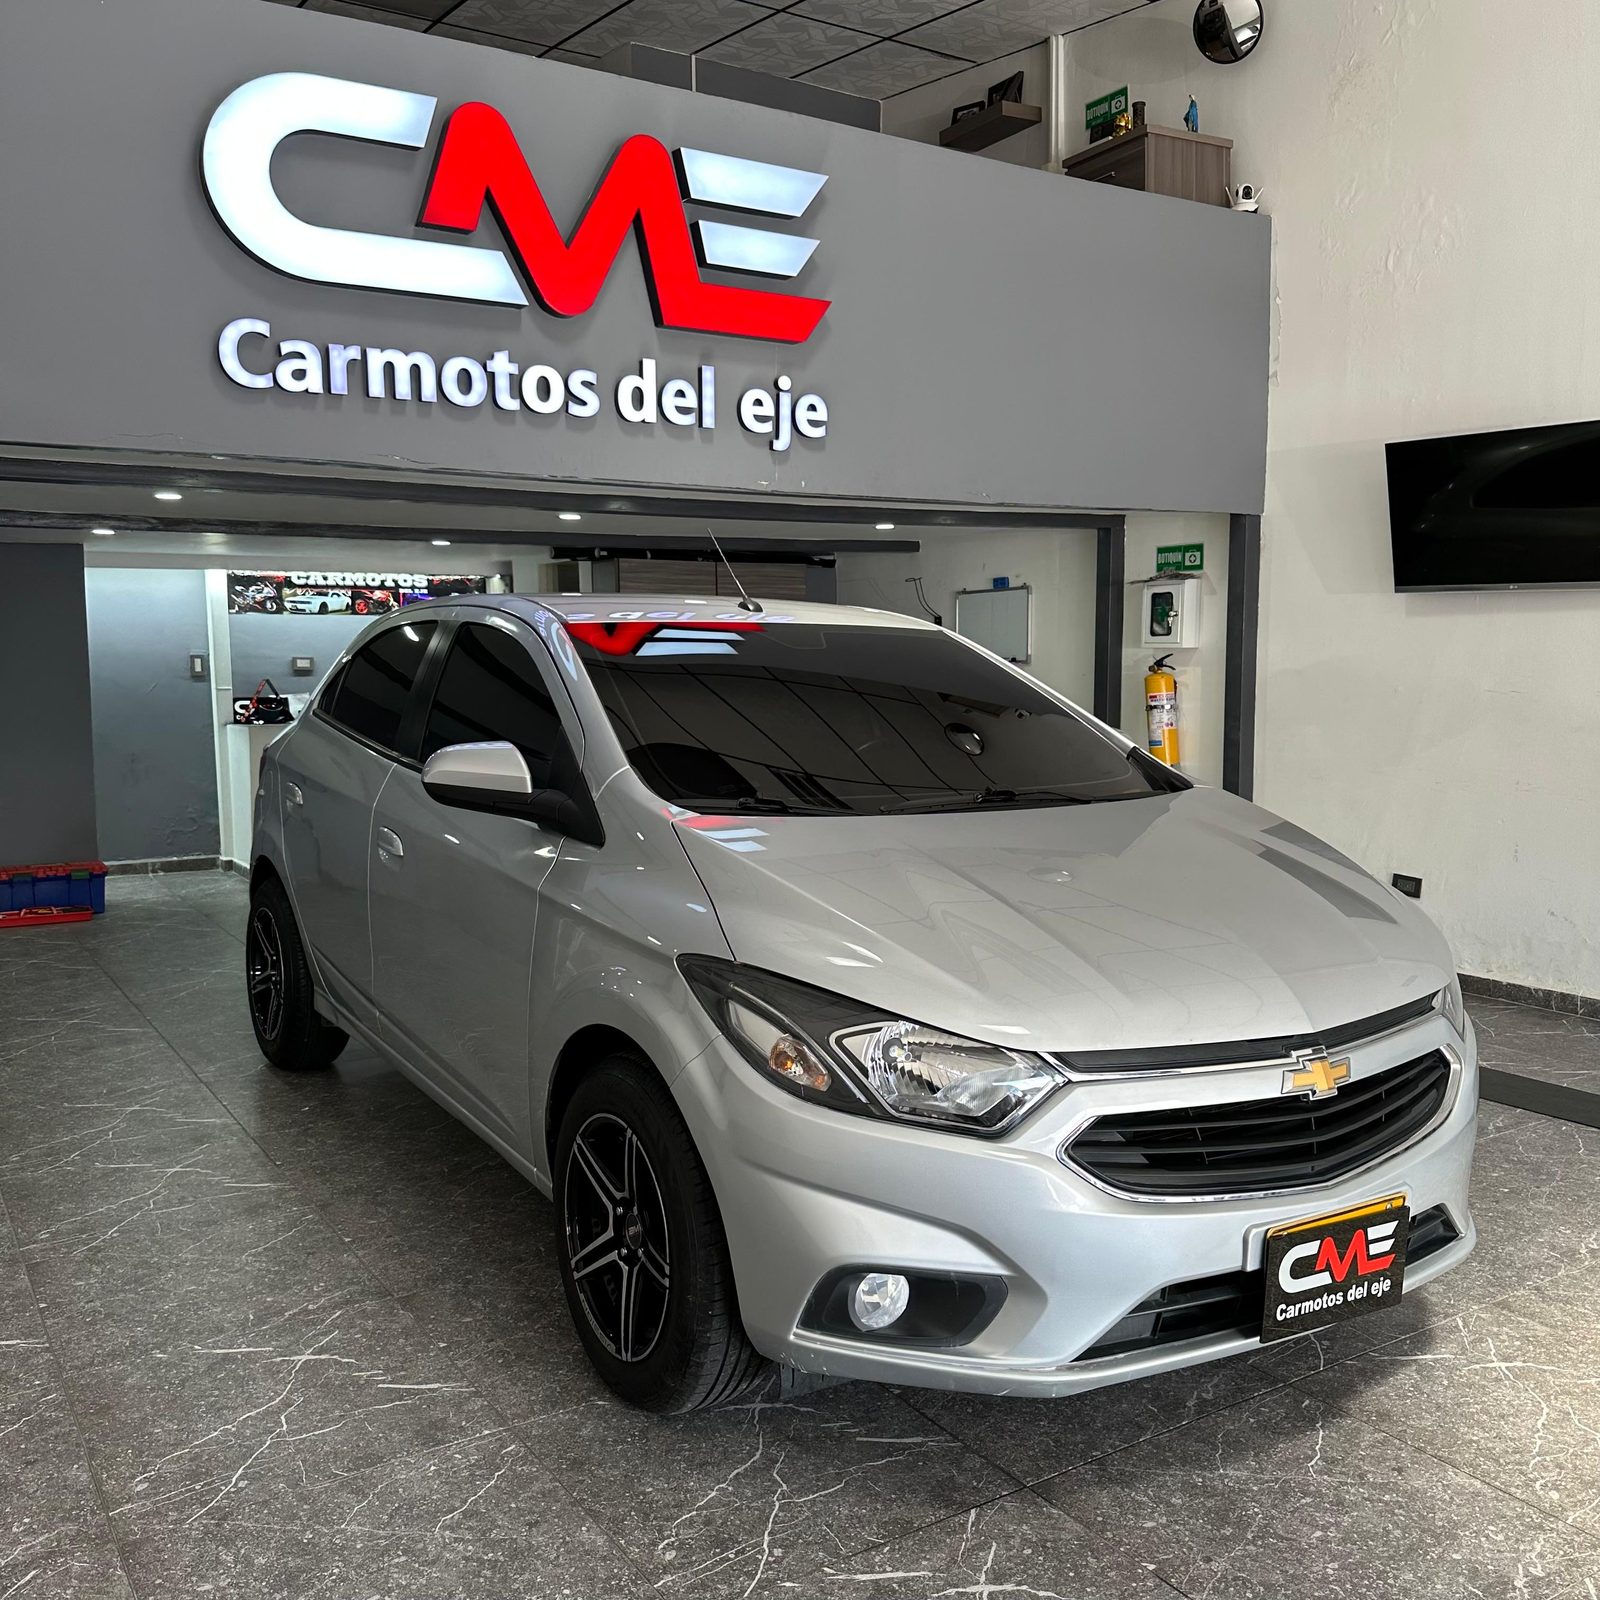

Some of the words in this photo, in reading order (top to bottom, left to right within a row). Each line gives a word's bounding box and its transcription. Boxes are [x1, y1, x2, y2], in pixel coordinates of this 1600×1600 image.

[202, 71, 832, 343] CME
[217, 316, 601, 419] Carmotos
[616, 357, 715, 429] del
[738, 374, 829, 452] eje
[290, 571, 429, 587] CARMOTOS
[1278, 1220, 1400, 1294] CME
[1275, 1290, 1344, 1322] Carmotos
[1346, 1281, 1368, 1302] del
[1371, 1277, 1391, 1297] eje
